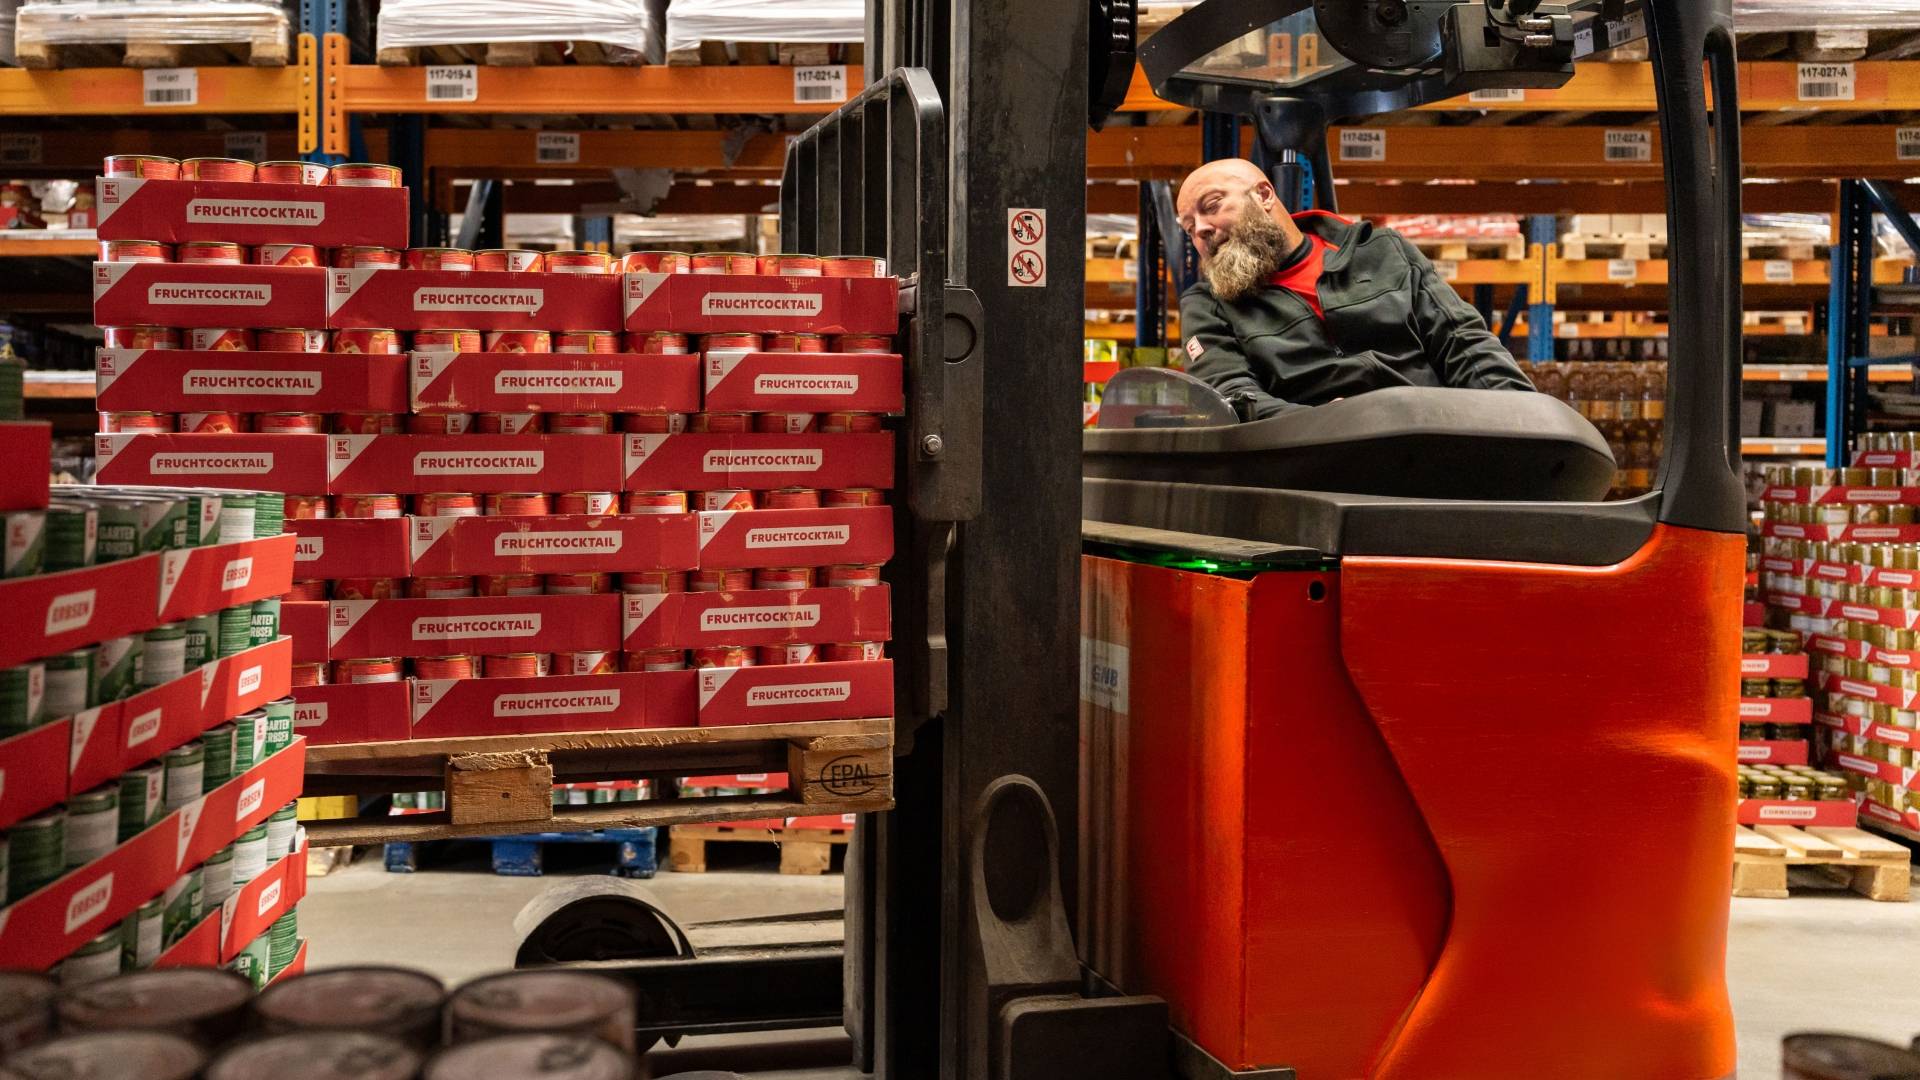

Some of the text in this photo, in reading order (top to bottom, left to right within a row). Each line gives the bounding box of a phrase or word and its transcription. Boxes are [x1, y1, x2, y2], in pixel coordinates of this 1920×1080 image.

[429, 72, 471, 83] 117-019-A
[797, 70, 840, 82] 117-021-A
[1801, 67, 1848, 79] 117-027-A
[1898, 133, 1920, 144] 117-0
[194, 205, 318, 219] FRUCHTCOCKTAIL
[155, 288, 265, 300] FRUCHTCOCKTAIL
[420, 293, 537, 306] FRUCHTCOCKTAIL
[709, 298, 816, 310] FRUCHTCOCKTAIL
[190, 376, 314, 389] FRUCHTCOCKTAIL
[501, 375, 616, 388] FRUCHTCOCKTAIL
[760, 379, 853, 389] FRUCHTCOCKTAIL
[156, 457, 267, 469] FRUCHTCOCKTAIL
[420, 456, 537, 468] FRUCHTCOCKTAIL
[709, 455, 817, 466] FRUCHTCOCKTAIL
[501, 536, 616, 549] FRUCHTCOCKTAIL
[751, 530, 845, 542] FRUCHTCOCKTAIL
[225, 566, 249, 584] ERBSEN
[51, 601, 90, 624] ERBSEN
[706, 610, 814, 624] FRUCHTCOCKTAIL
[251, 614, 274, 627] ARTEN
[418, 620, 535, 634] FRUCHTCOCKTAIL
[250, 626, 273, 639] RBSEN
[752, 687, 845, 701] FRUCHTCOCKTAIL
[500, 696, 614, 710] FRUCHTCOCKTAIL
[831, 763, 874, 789] EPAL
[239, 789, 262, 812] ERBSEN
[71, 884, 108, 920] ERBSEN
[260, 887, 279, 910] ERBSEN
